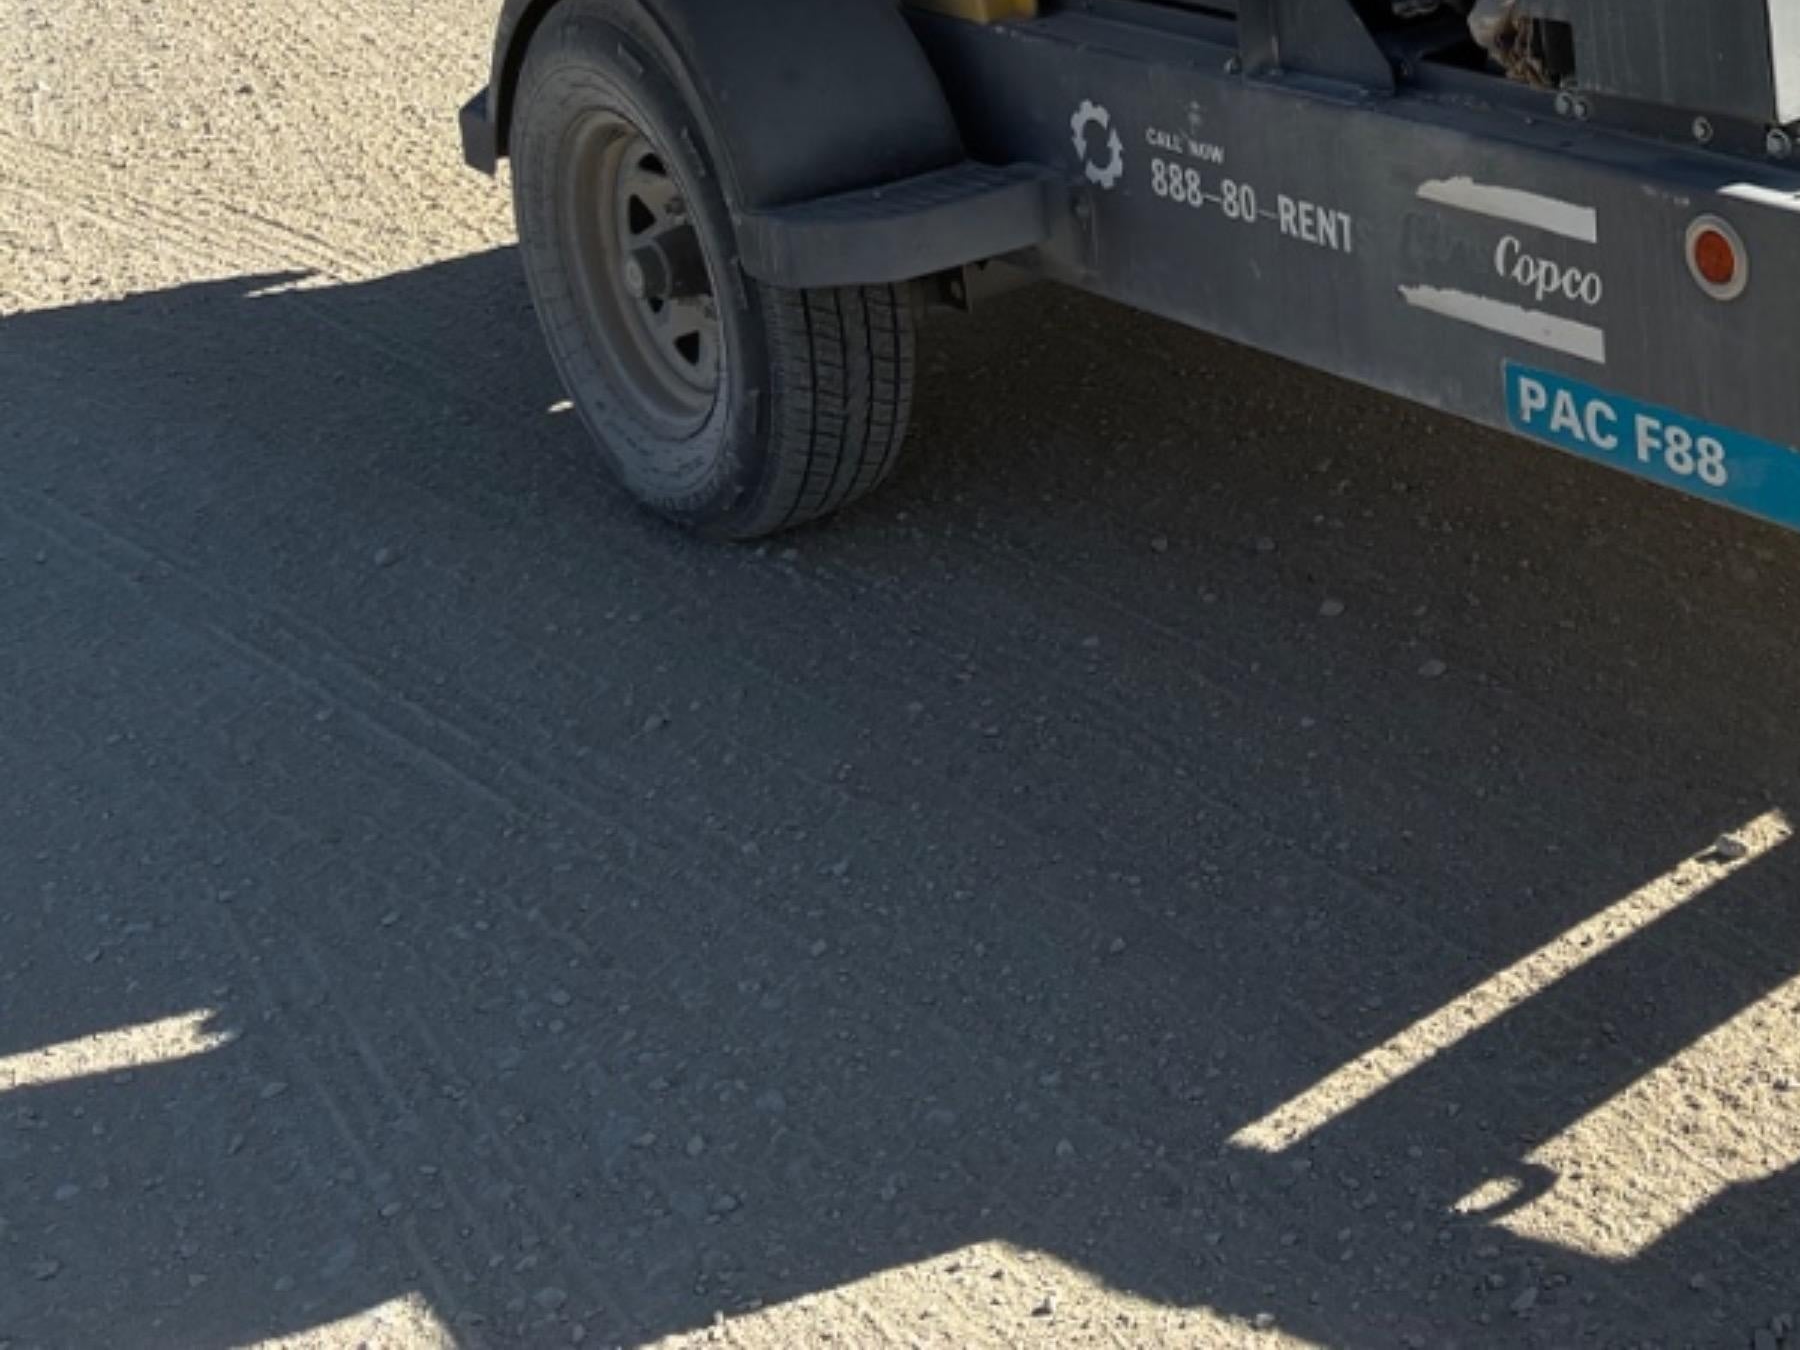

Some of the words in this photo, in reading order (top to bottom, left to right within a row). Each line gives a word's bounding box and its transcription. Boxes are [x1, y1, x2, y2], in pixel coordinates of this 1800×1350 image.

[1145, 127, 1184, 154] CALL
[1187, 140, 1226, 165] NOW
[1150, 157, 1352, 254] 888-80-RENT
[1493, 234, 1603, 306] Copco
[1518, 375, 1619, 451] PAC
[1634, 413, 1730, 488] F88
